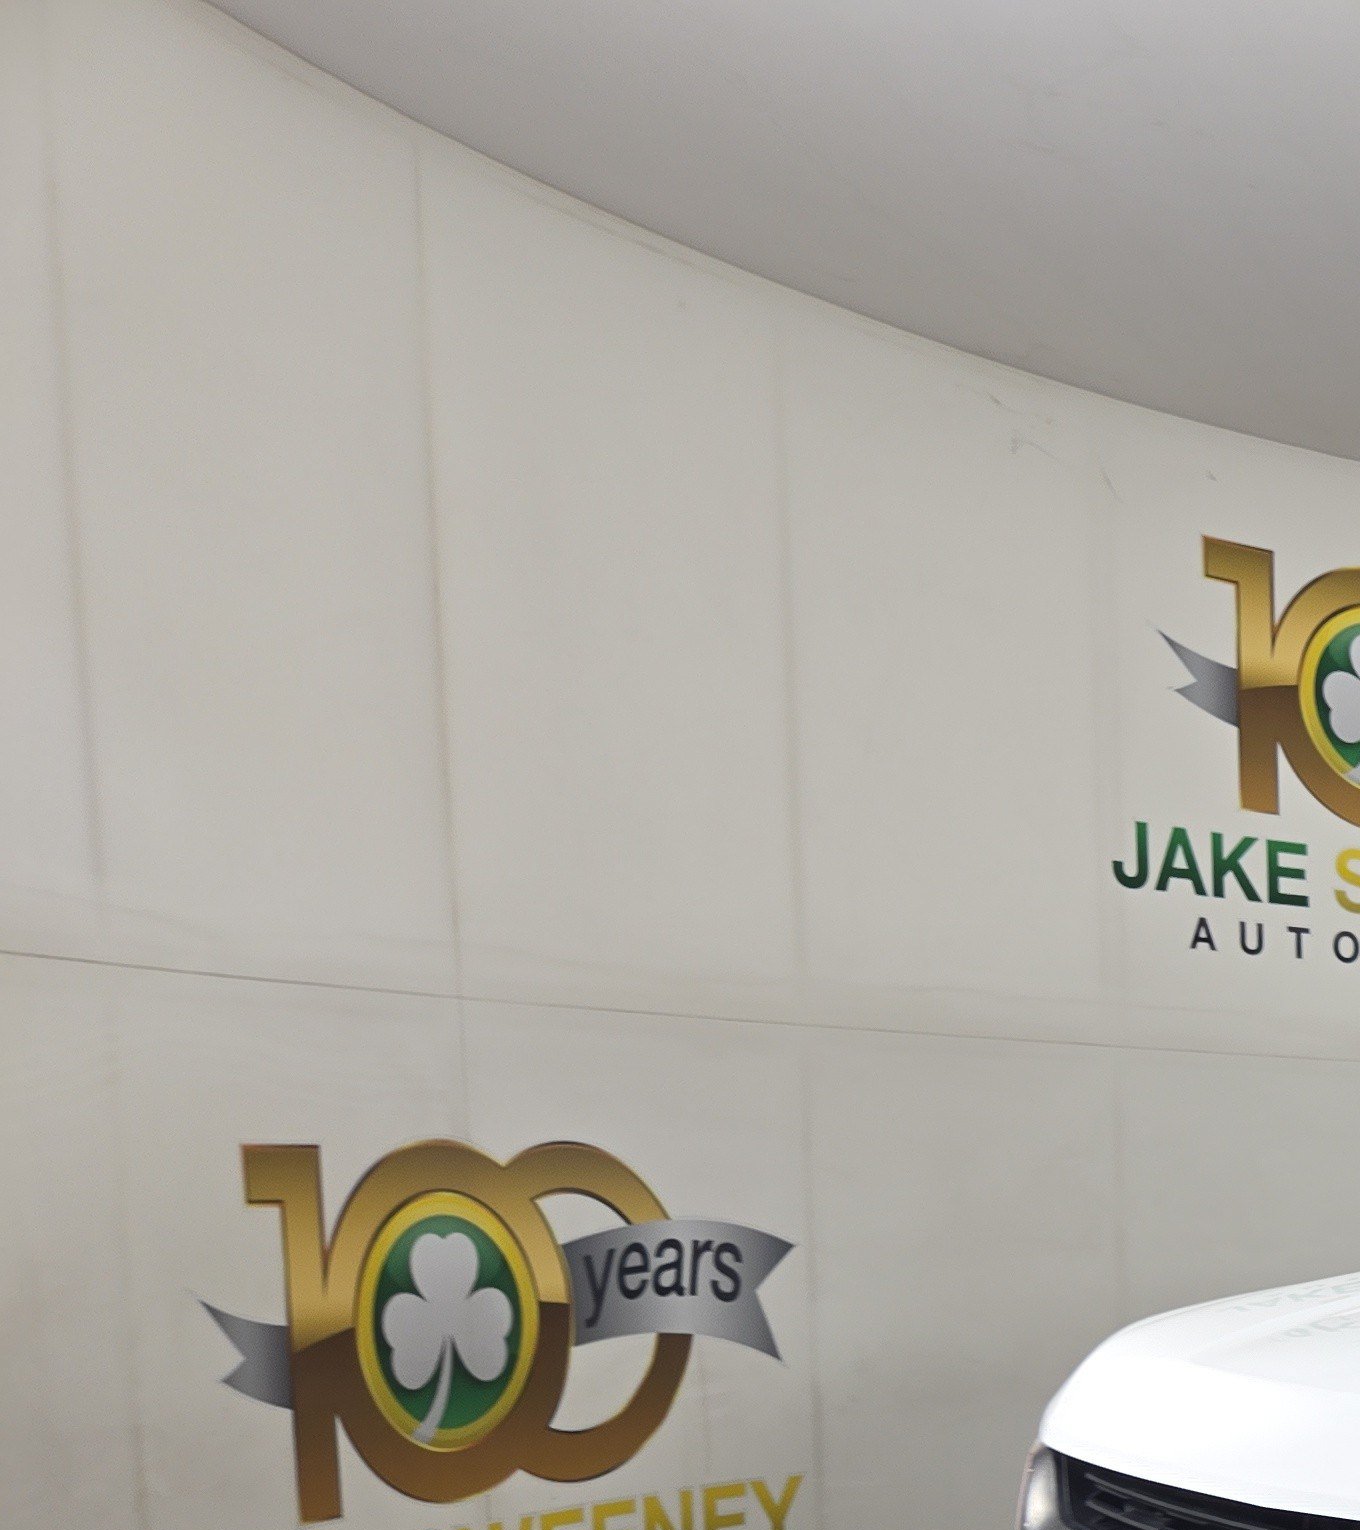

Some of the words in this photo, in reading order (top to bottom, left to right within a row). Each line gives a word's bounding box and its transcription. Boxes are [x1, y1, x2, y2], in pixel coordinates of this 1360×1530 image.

[1112, 819, 1310, 909] JAKE
[582, 1236, 743, 1328] years
[241, 1138, 692, 1524] 100
